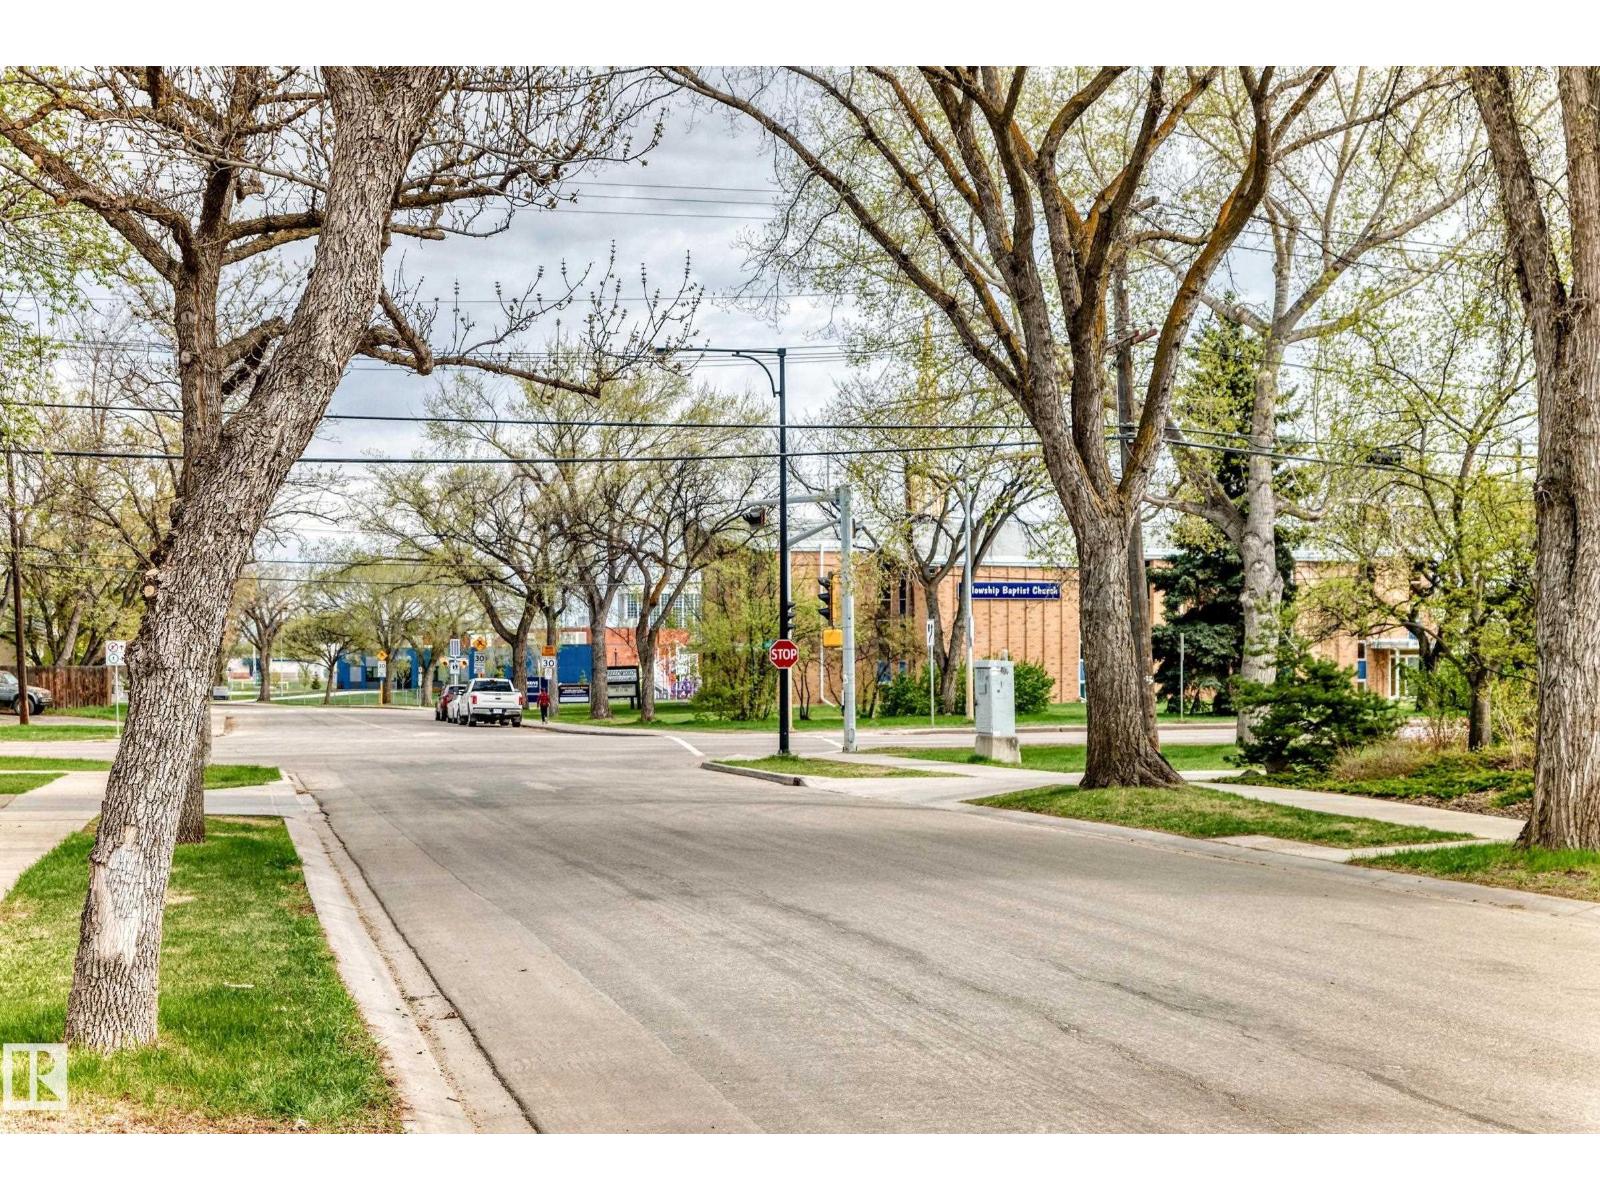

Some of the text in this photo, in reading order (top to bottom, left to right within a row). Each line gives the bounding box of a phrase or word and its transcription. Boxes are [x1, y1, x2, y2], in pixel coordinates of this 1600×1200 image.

[971, 585, 1058, 597] lowship Baptist Church
[771, 648, 797, 660] STOP
[543, 659, 555, 667] 30
